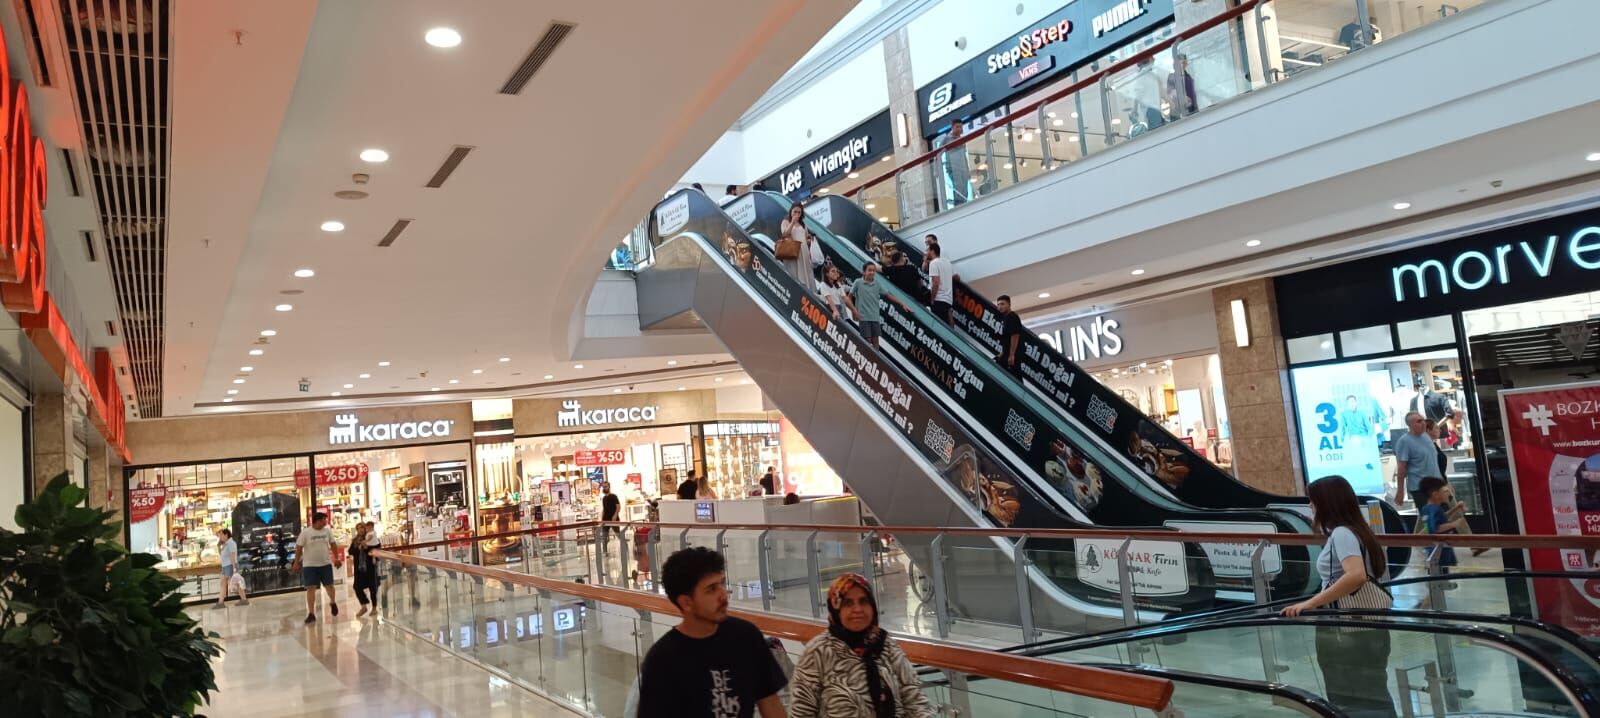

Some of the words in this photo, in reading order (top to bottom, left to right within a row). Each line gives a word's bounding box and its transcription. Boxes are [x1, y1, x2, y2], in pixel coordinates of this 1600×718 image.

[780, 166, 802, 196] Lee
[810, 135, 868, 179] Wrangler
[1392, 226, 1600, 302] morve
[801, 296, 828, 330] %100
[825, 320, 848, 350] Ekşi
[846, 340, 880, 381] Mayalı
[879, 371, 913, 411] Doğal
[879, 298, 889, 311] er
[888, 304, 917, 336] Damak
[916, 327, 953, 365] Zevkine
[952, 356, 984, 392] Uygun
[791, 310, 813, 338] Ekmek
[812, 332, 857, 379] Çeşitlerimizi
[855, 374, 895, 418] Denediniz
[894, 414, 908, 433] mi
[1020, 361, 1056, 394] enediniz
[1055, 389, 1070, 405] mi
[1040, 354, 1075, 388] Doğal
[359, 419, 449, 442] karaca
[582, 406, 656, 425] karaca
[1315, 402, 1338, 434] 3
[595, 451, 623, 463] %50
[1319, 435, 1343, 450] AL
[324, 467, 357, 482] %50
[132, 497, 156, 507] %50
[1103, 548, 1152, 563] KÖNAR
